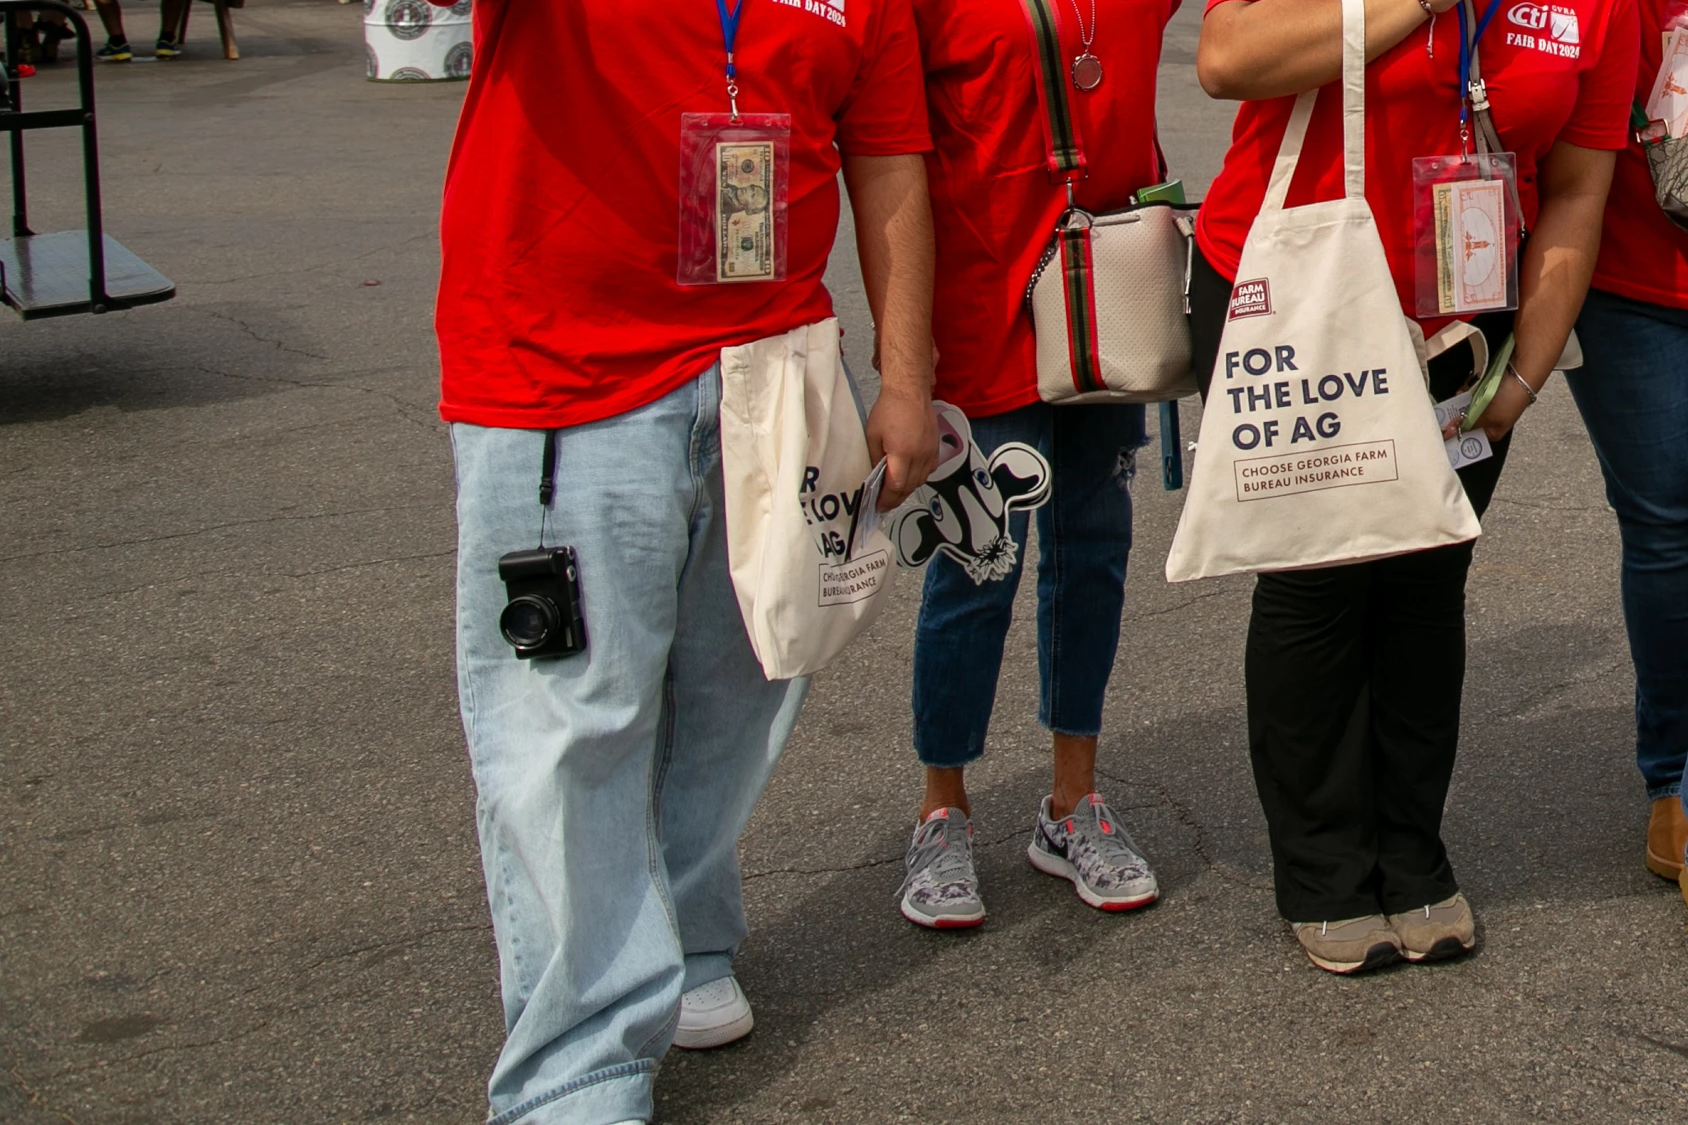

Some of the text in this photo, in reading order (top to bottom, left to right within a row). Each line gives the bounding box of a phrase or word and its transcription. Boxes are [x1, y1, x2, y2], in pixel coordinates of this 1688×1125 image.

[826, 7, 846, 27] 2024
[1513, 4, 1549, 28] cti
[1551, 4, 1576, 16] GVRA
[1506, 32, 1580, 59] FAIR DAY 2024
[1231, 292, 1265, 308] BUREAU
[1238, 283, 1264, 296] FARM
[1225, 344, 1299, 379] FOR
[1226, 368, 1390, 414] THE LOVE
[1232, 412, 1341, 451] OF AG
[1242, 449, 1388, 479] CHOOSE GEORGIA FARM
[1243, 466, 1364, 493] BUREAU INSURANCE
[811, 489, 861, 523] LOV
[821, 530, 846, 558] AG
[866, 558, 886, 573] FARM
